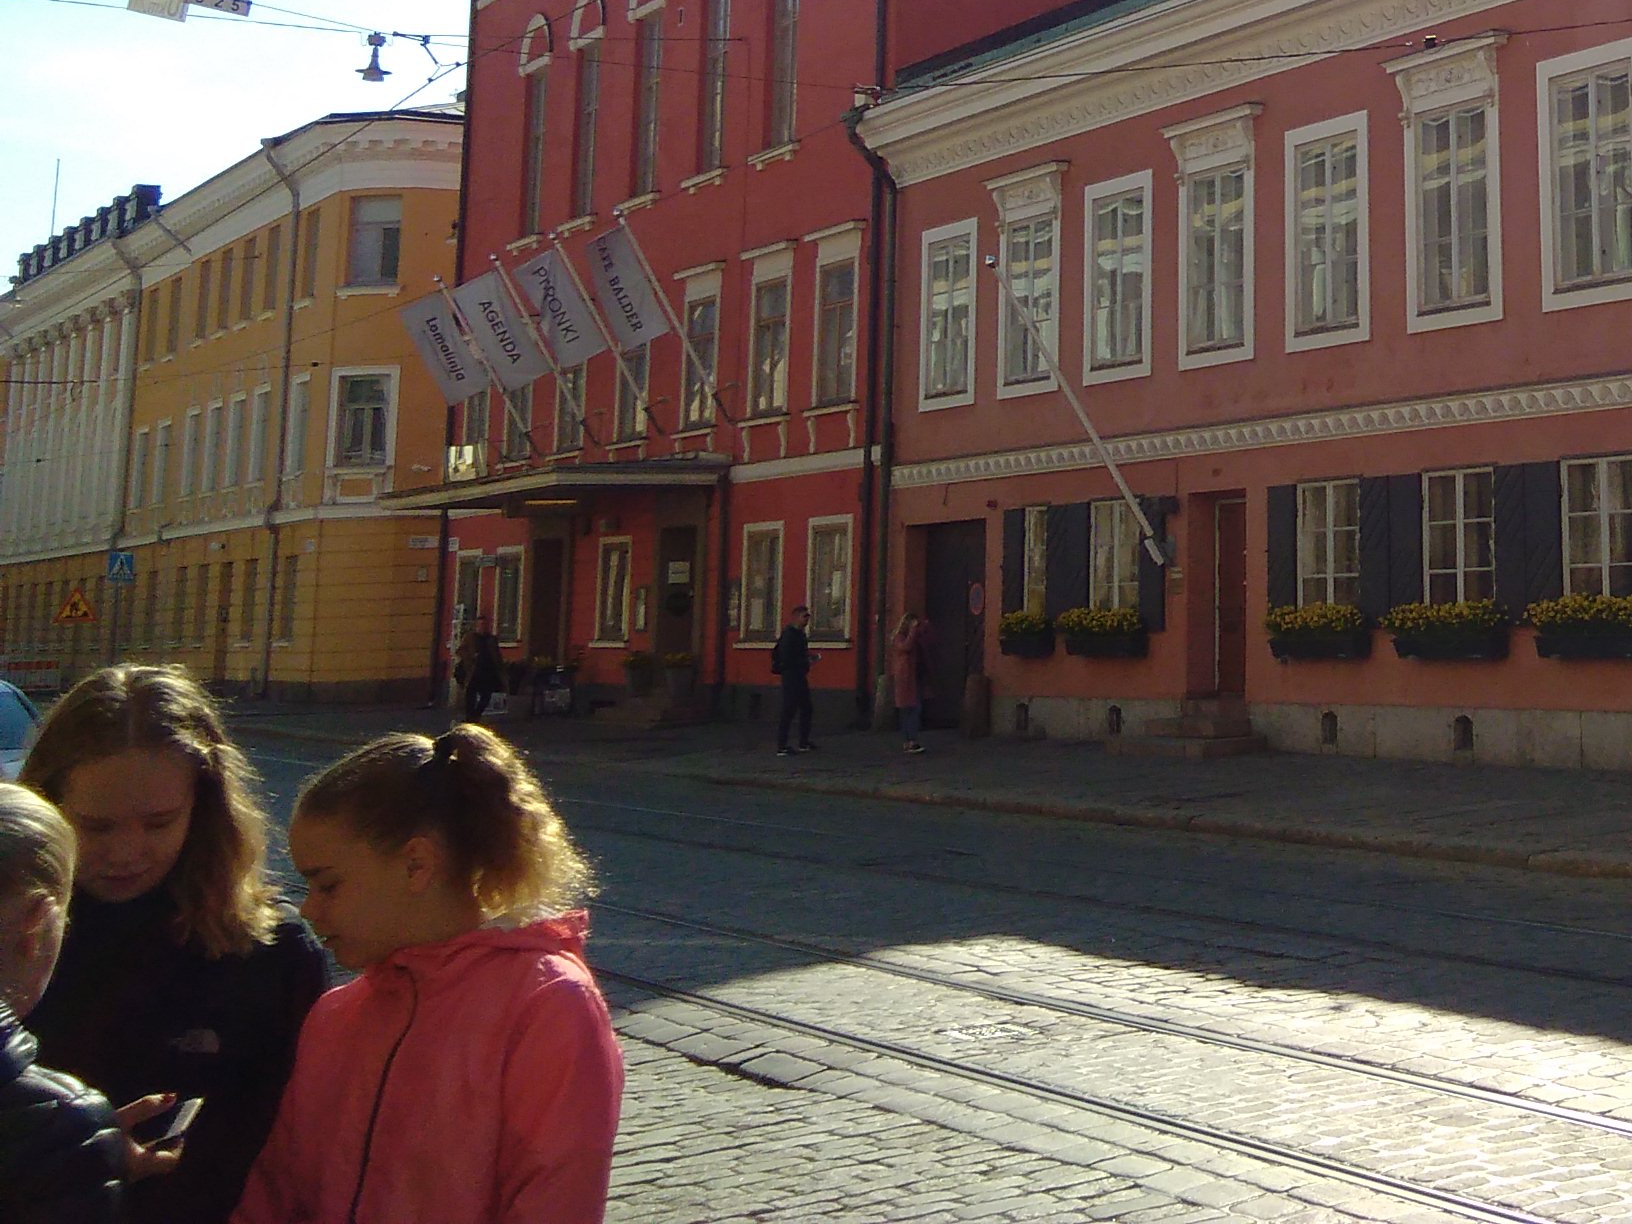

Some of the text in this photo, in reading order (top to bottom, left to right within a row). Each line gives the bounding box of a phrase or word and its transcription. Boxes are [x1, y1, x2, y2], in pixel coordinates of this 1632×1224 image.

[478, 299, 522, 366] AGENDA
[608, 275, 644, 333] BALDER
[425, 316, 467, 383] Lomalinja
